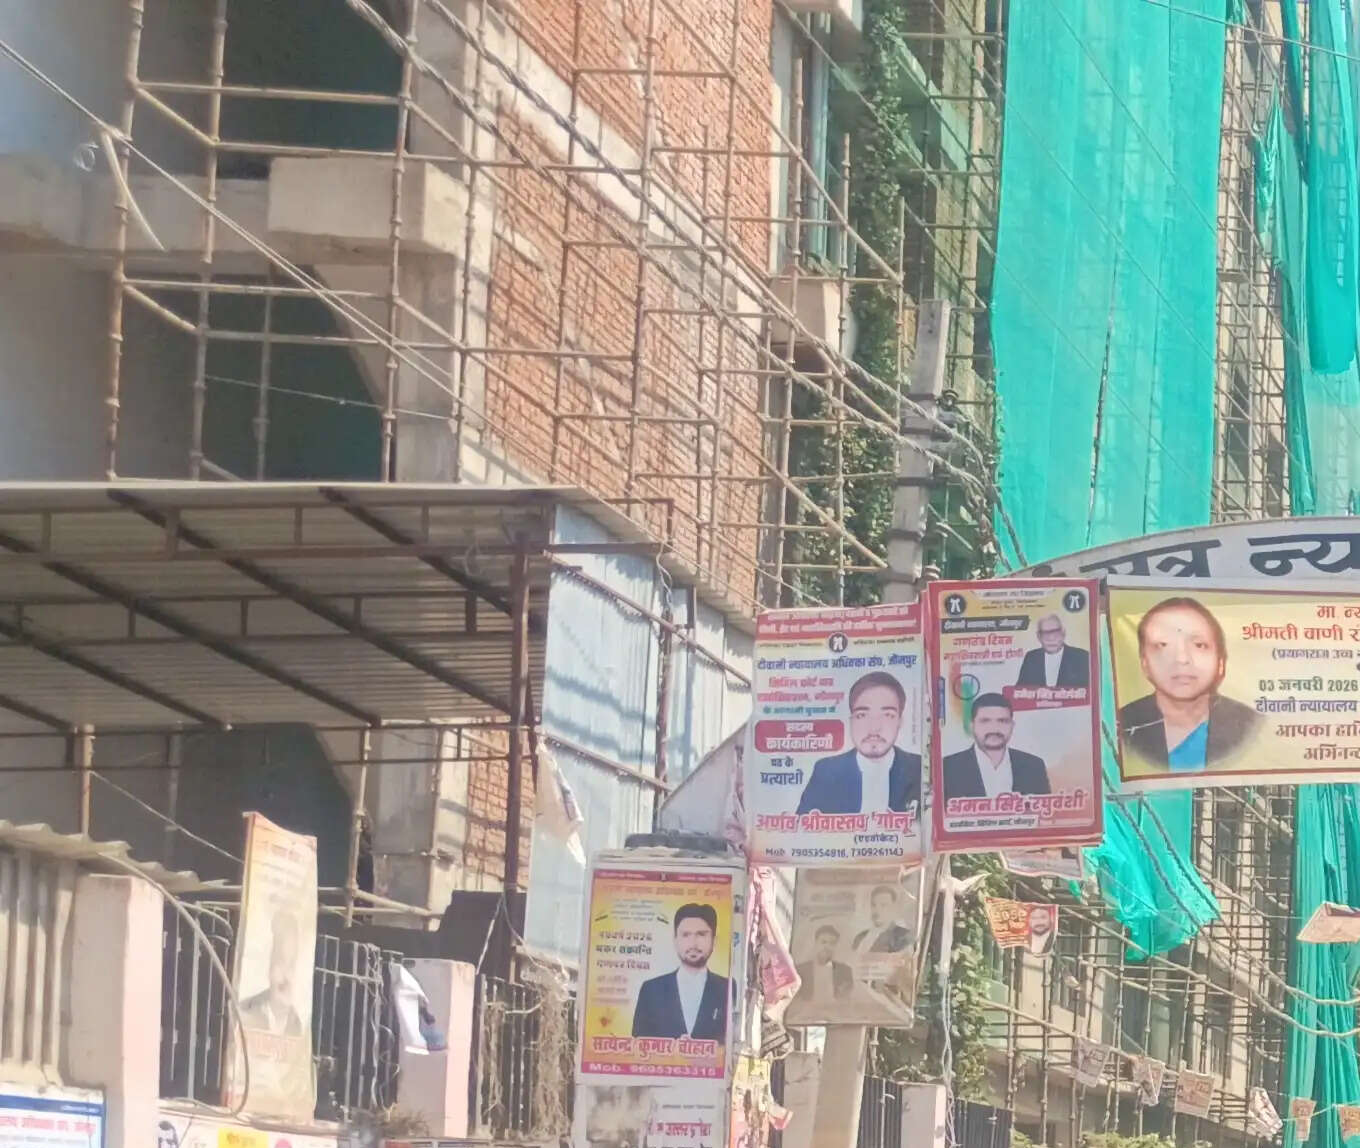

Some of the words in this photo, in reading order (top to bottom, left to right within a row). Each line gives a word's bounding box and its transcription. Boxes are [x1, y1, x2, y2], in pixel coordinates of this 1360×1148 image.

[1241, 622, 1299, 642] श्रीमती
[1303, 624, 1344, 642] वाणी
[1278, 676, 1325, 693] जनवरी
[1327, 678, 1359, 692] 2026
[1256, 696, 1297, 714] दीवानी
[1299, 699, 1357, 714] न्यायालय
[1275, 723, 1331, 738] आपका
[760, 769, 804, 786] प्रत्याशी
[949, 798, 991, 814] अमन
[801, 809, 870, 832] श्रीवास्तव
[638, 1037, 674, 1060] कुमार
[677, 1033, 718, 1058] चौहान
